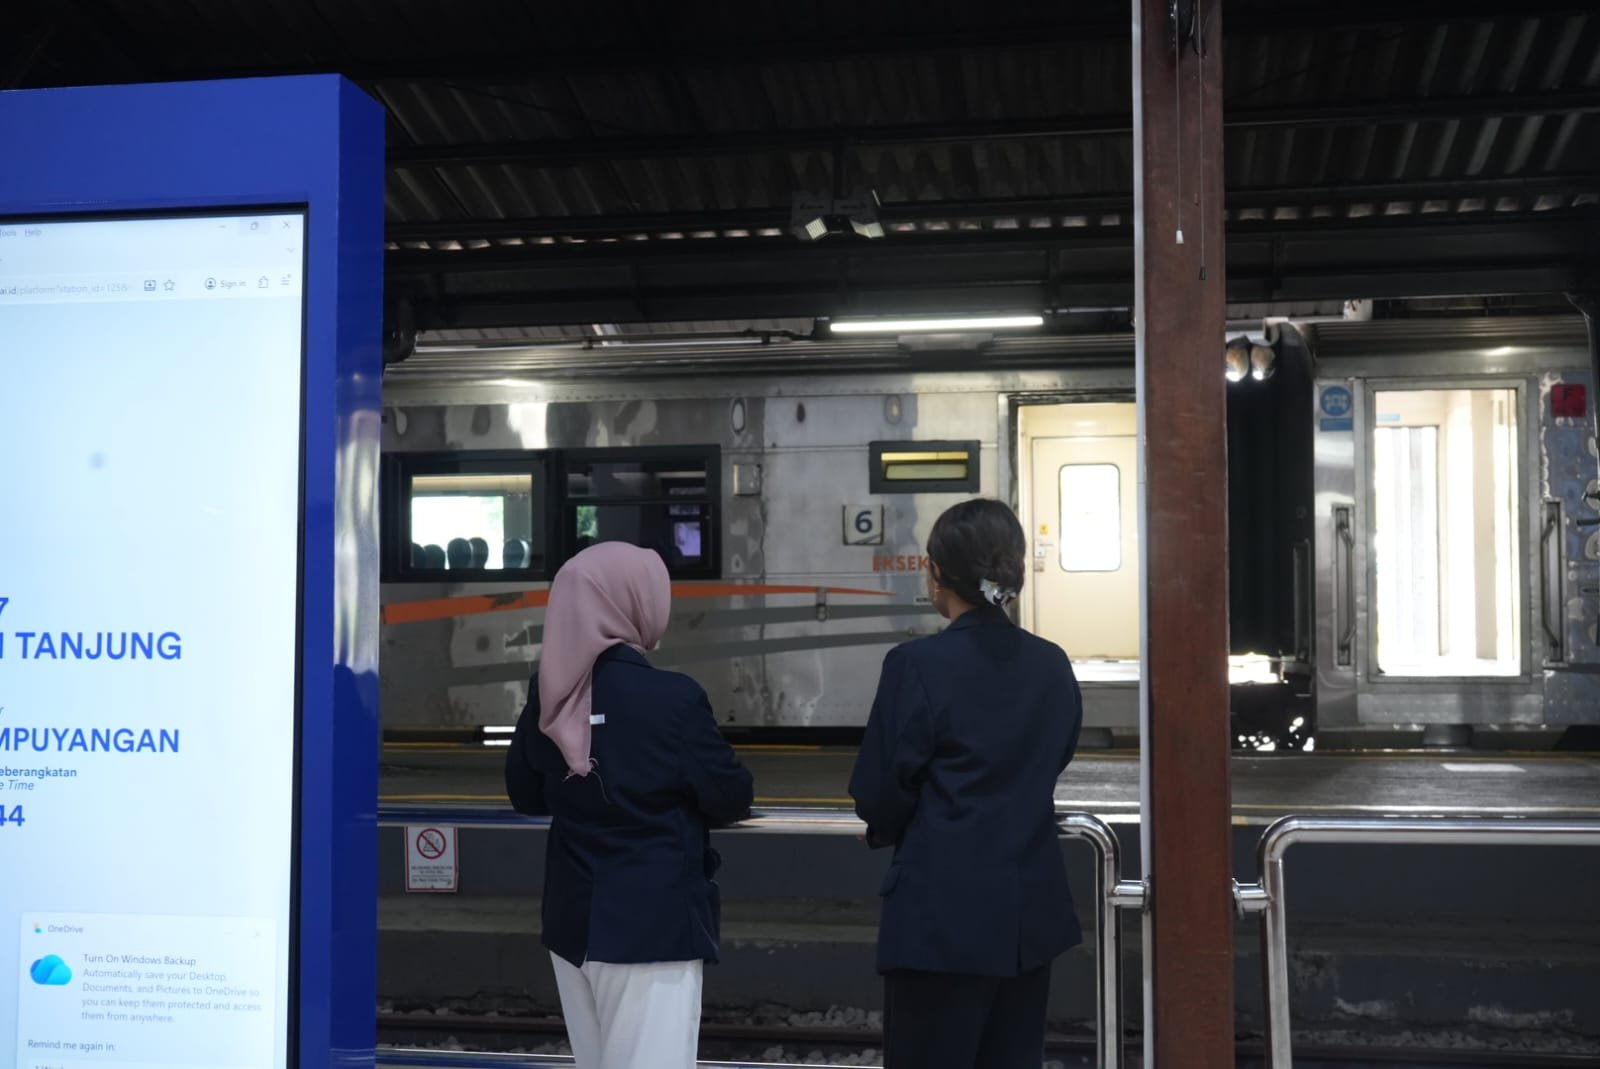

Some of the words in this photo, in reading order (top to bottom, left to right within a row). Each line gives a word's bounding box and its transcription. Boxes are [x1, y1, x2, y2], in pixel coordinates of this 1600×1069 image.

[220, 280, 236, 290] Sign
[854, 510, 873, 533] 6
[15, 631, 182, 660] TANJUNG
[8, 779, 35, 791] Time
[47, 924, 84, 934] OneDrive
[83, 954, 104, 964] Turn
[106, 954, 119, 964] On
[121, 954, 162, 965] Windows
[164, 956, 196, 967] Backup
[83, 969, 142, 981] Automatically
[144, 971, 164, 980] save
[166, 971, 186, 982] your
[136, 984, 154, 993] and
[156, 985, 190, 995] Pictures
[193, 985, 203, 995] to
[205, 986, 247, 997] OneDrive
[249, 989, 260, 997] so
[81, 998, 99, 1009] you
[101, 998, 116, 1008] can
[118, 997, 140, 1010] keep
[142, 998, 166, 1009] them
[168, 1000, 211, 1012] protected
[213, 1001, 231, 1011] and
[232, 1003, 263, 1012] access
[81, 1011, 105, 1021] them
[107, 1011, 128, 1022] from
[129, 1012, 175, 1024] anywhere.
[28, 1040, 61, 1050] Remind
[63, 1042, 77, 1050] me
[79, 1041, 104, 1053] again
